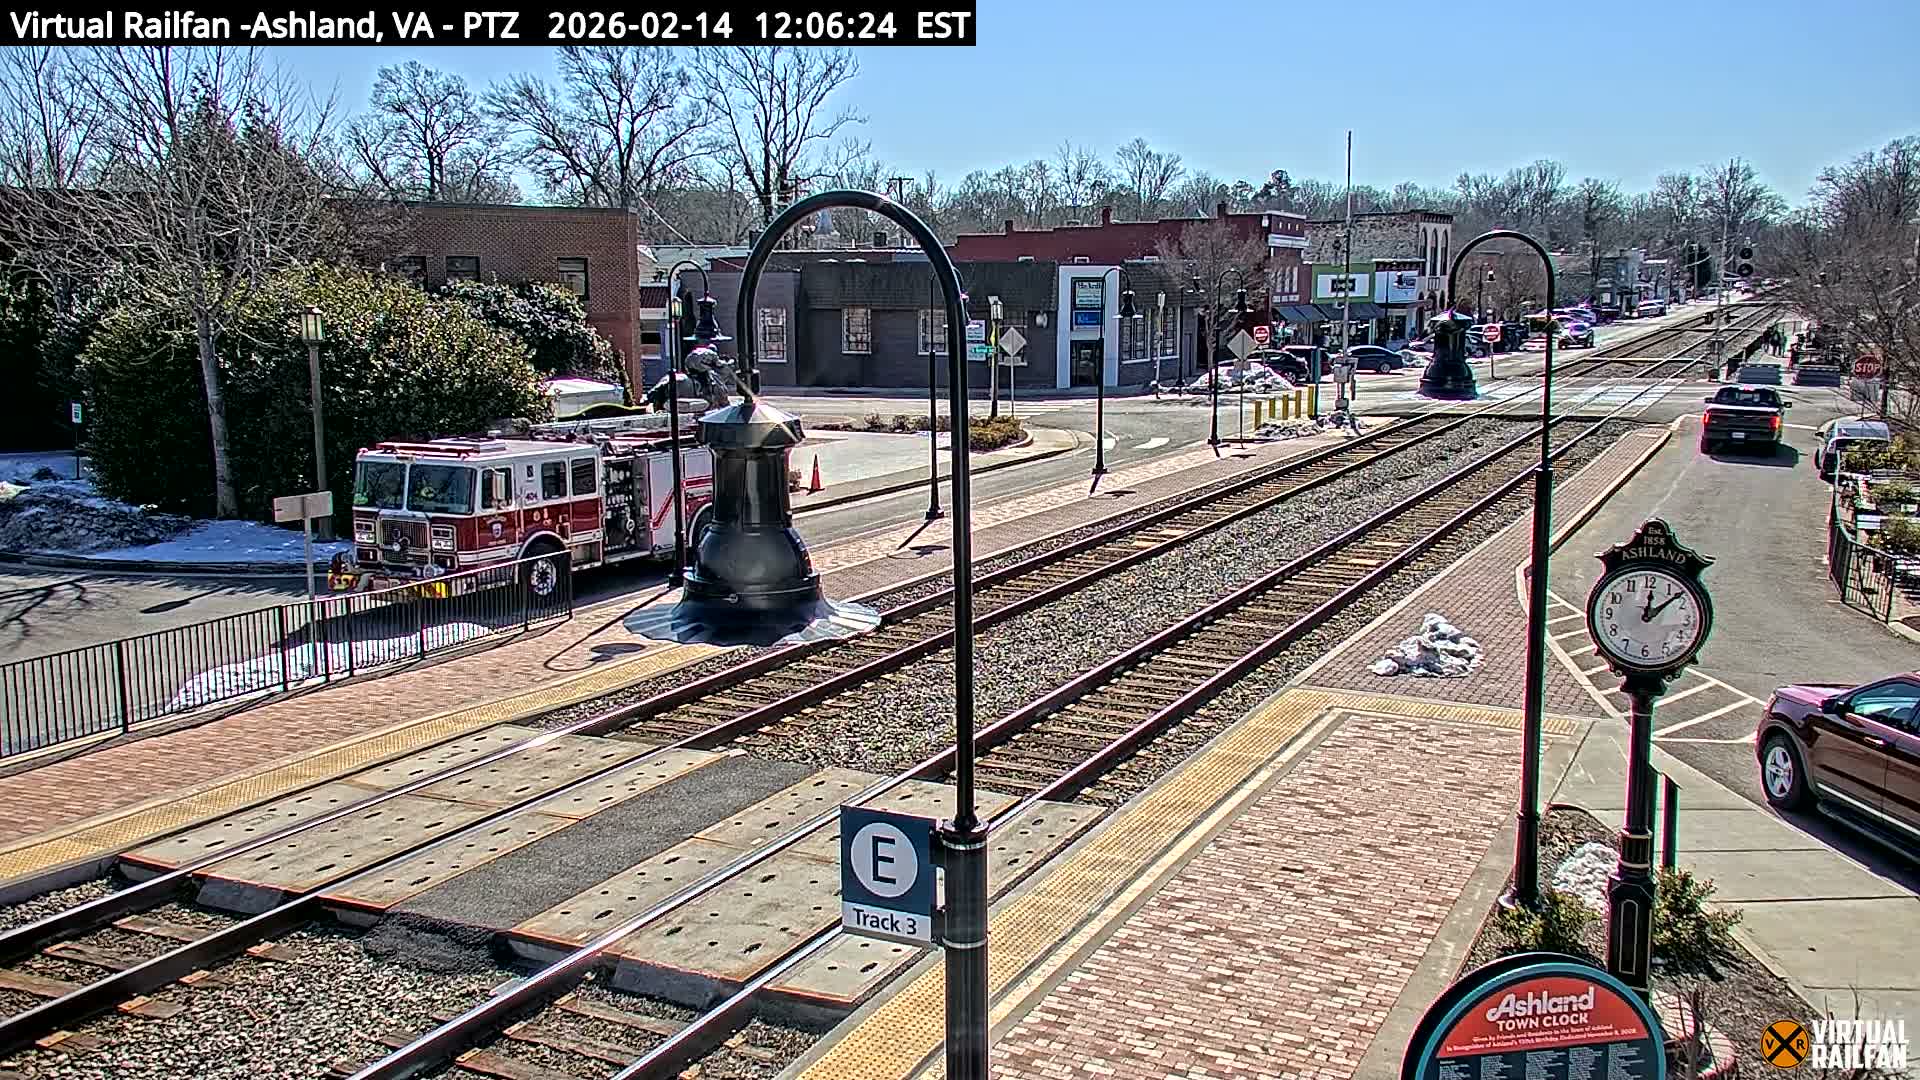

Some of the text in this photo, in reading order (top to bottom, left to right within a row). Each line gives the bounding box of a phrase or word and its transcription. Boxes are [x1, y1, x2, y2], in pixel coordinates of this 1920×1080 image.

[1855, 362, 1881, 373] STOP
[1643, 536, 1665, 545] 1858
[1622, 546, 1687, 564] ASHLAND
[1626, 580, 1636, 592] 11
[1643, 576, 1657, 589] 12
[1666, 583, 1672, 596] 1
[1611, 592, 1622, 604] 10
[1679, 597, 1687, 610] 2
[1605, 608, 1613, 620] 9
[1683, 615, 1691, 627] 3
[1609, 624, 1618, 636] 8
[1677, 630, 1684, 640] 4
[1622, 639, 1630, 654] 7
[1641, 645, 1649, 657] 6
[1661, 642, 1670, 656] 5
[872, 835, 896, 884] E
[853, 908, 917, 935] Track 3
[1486, 986, 1594, 1022] Ashland
[1496, 1012, 1588, 1032] TOWN CLOCK
